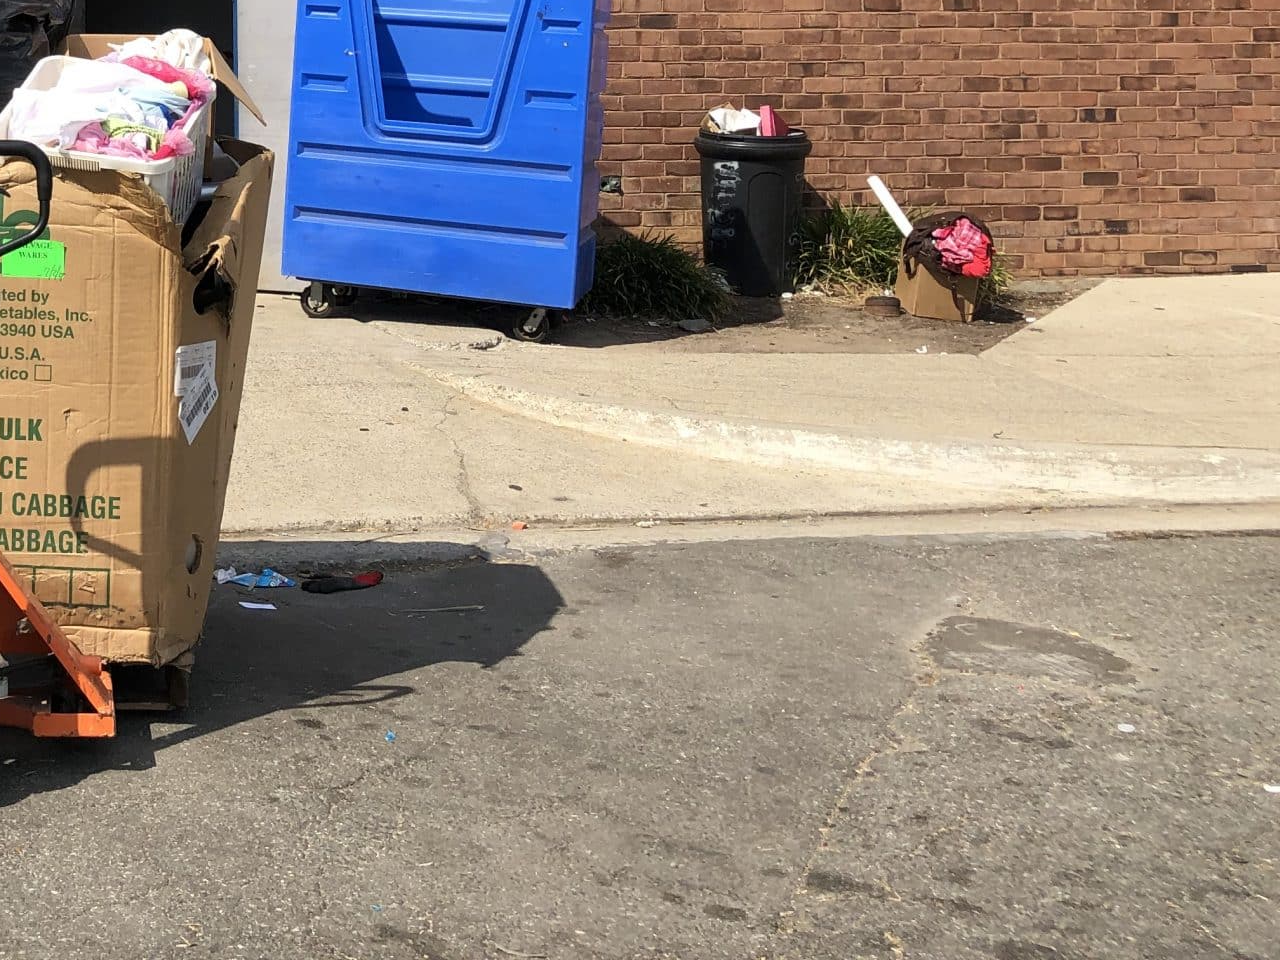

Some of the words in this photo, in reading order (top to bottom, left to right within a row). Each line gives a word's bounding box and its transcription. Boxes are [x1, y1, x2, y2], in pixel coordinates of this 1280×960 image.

[19, 251, 48, 259] WARES
[32, 290, 50, 305] by
[66, 308, 93, 322] Inc.
[42, 325, 74, 339] USA
[0, 346, 45, 361] U.S.A.
[12, 493, 120, 520] CABBAGE
